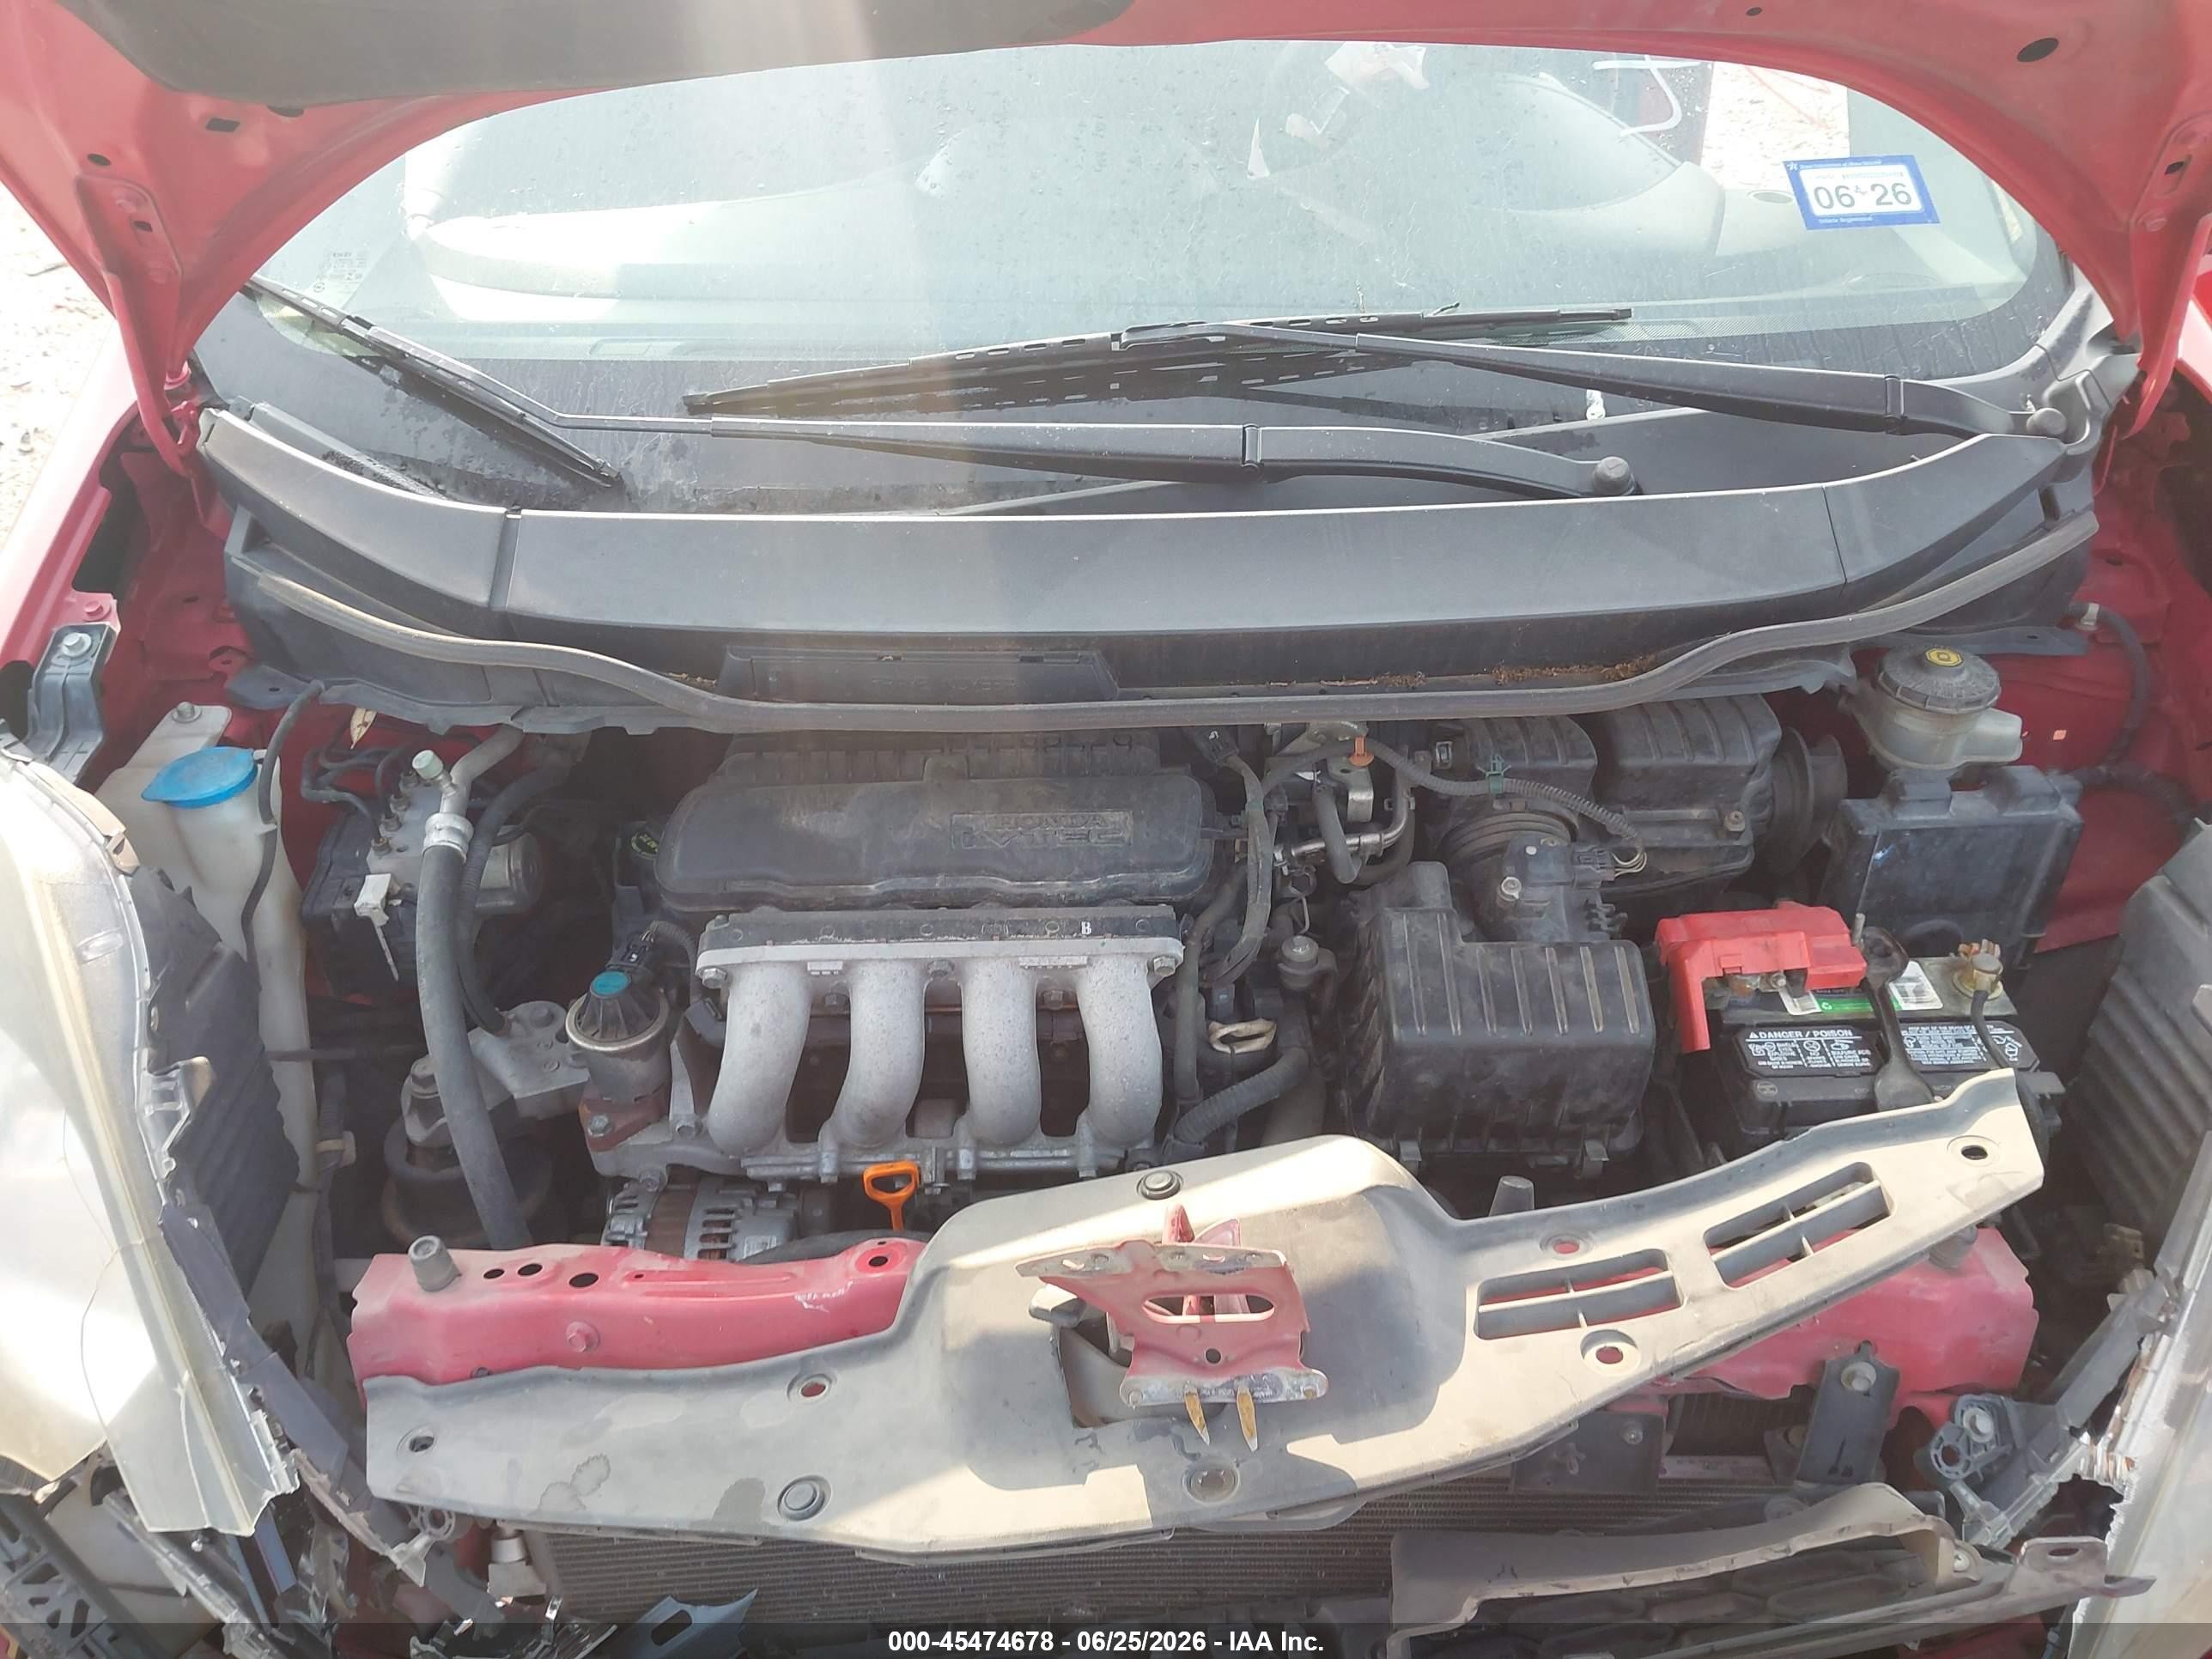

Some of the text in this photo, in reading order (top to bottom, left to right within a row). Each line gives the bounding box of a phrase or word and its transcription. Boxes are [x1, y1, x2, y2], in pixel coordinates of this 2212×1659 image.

[1814, 183, 1911, 209] 06 26
[1081, 921, 1092, 935] B
[1759, 1030, 1803, 1039] DANGER
[1813, 1029, 1853, 1038] POISON
